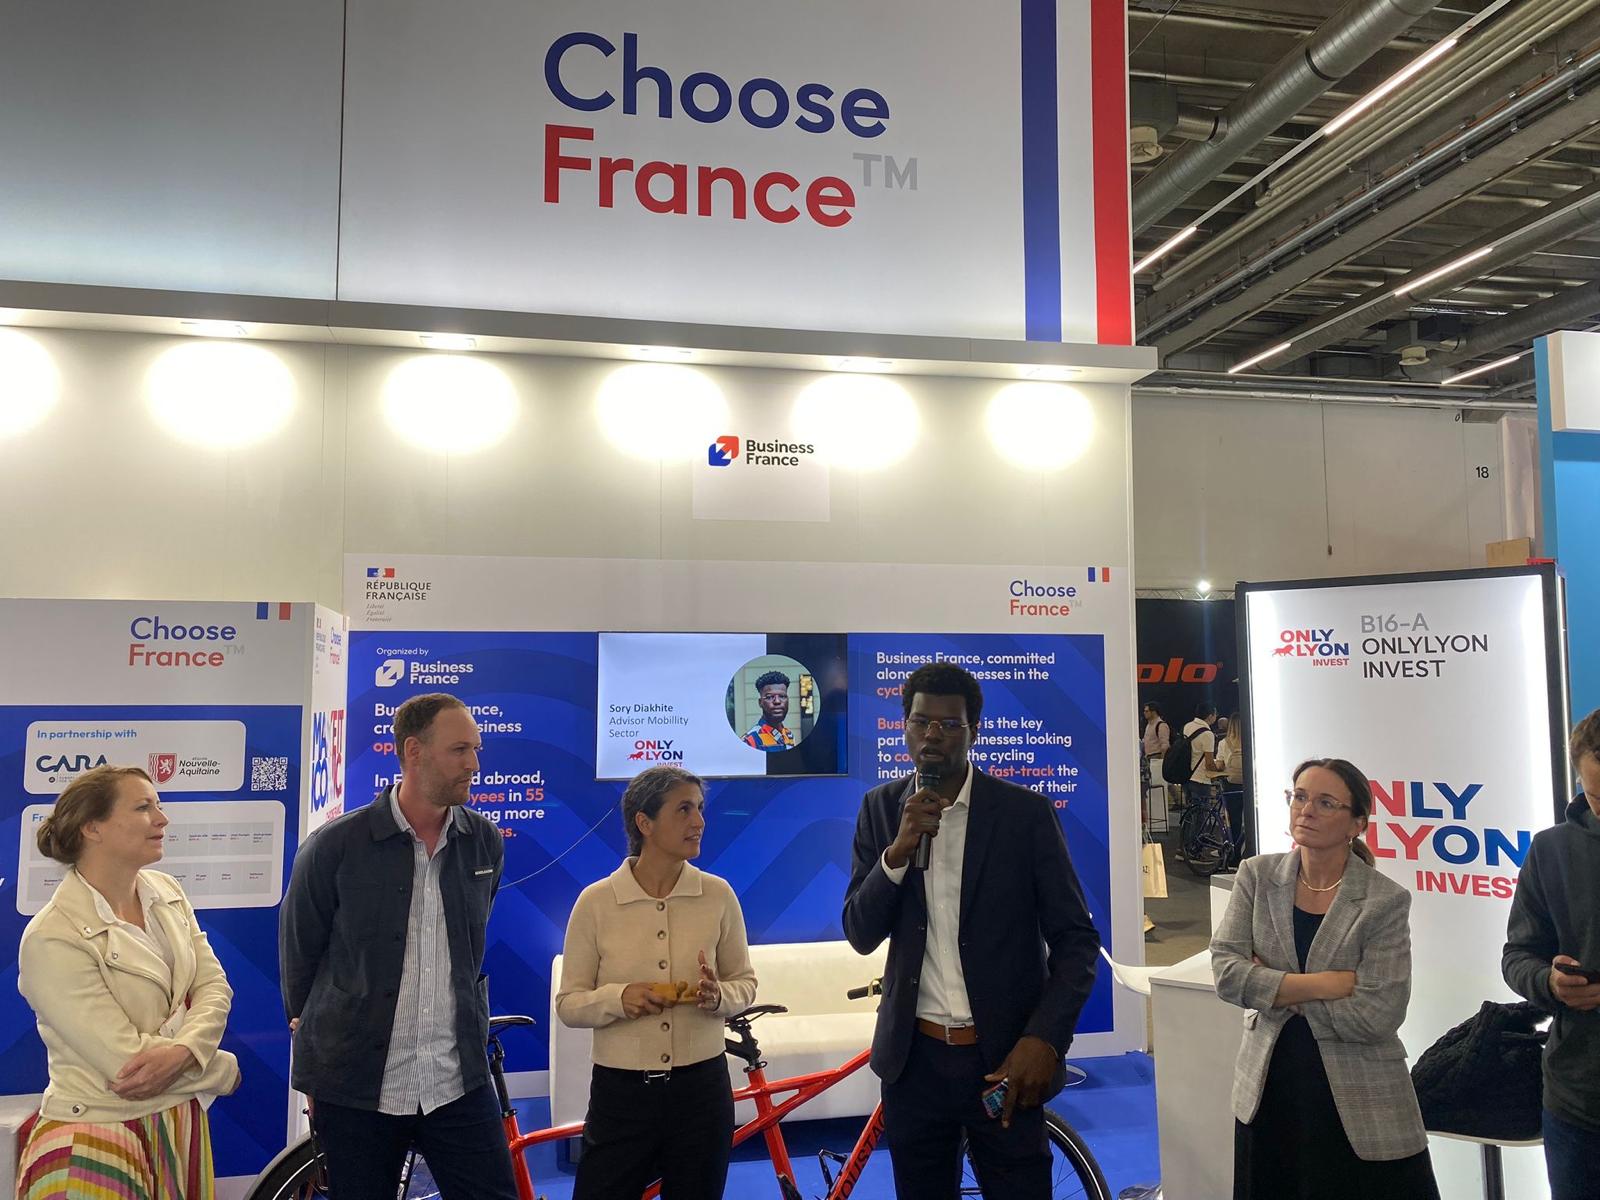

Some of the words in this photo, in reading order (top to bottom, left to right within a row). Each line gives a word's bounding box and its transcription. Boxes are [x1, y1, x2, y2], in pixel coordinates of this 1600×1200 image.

[544, 32, 890, 138] Choose
[544, 123, 856, 228] France
[746, 439, 815, 454] Business
[746, 453, 799, 466] France
[1475, 466, 1489, 479] 18
[366, 580, 432, 592] RÉPUBLIQUE
[1010, 579, 1077, 597] Choose
[366, 591, 427, 601] FRANÇAISE
[1010, 599, 1070, 616] France
[130, 616, 237, 640] Choose
[1361, 613, 1429, 633] B16-A
[1280, 629, 1334, 643] ONLY
[1296, 643, 1350, 657] LYON
[1362, 634, 1488, 655] ONLYLYON
[128, 643, 224, 667] France
[376, 648, 418, 656] Organized
[419, 648, 429, 656] by
[877, 651, 933, 664] Business
[935, 651, 984, 666] France,
[986, 651, 1055, 665] committed
[410, 661, 474, 673] Business
[1312, 658, 1350, 667] INVEST
[1363, 660, 1446, 678] INVEST
[410, 674, 459, 685] France
[966, 669, 1011, 680] nesses
[1014, 668, 1026, 680] in
[1027, 669, 1050, 680] the
[877, 683, 905, 699] cycl
[610, 704, 631, 714] Sory
[633, 703, 674, 713] Diakhite
[477, 719, 522, 733] siness
[609, 716, 645, 726] Advisor
[878, 717, 906, 730] Busi
[984, 717, 994, 729] is
[996, 717, 1019, 729] the
[1020, 717, 1043, 734] key
[37, 730, 48, 739] In
[49, 730, 112, 740] partnership
[114, 729, 137, 739] with
[609, 729, 640, 738] Sector
[634, 740, 674, 750] ONLY
[878, 734, 906, 749] part
[1026, 733, 1072, 749] looking
[646, 750, 683, 761] LYON
[878, 750, 892, 762] to
[967, 749, 988, 761] the
[990, 749, 1035, 765] cycling
[179, 759, 221, 768] Nouvelle-
[988, 764, 1055, 777] fast-track
[1057, 764, 1079, 776] the
[179, 767, 221, 777] Aquitaine
[375, 774, 389, 788] In
[484, 771, 545, 786] abroad,
[1030, 780, 1045, 793] of
[1047, 780, 1077, 793] their
[471, 792, 505, 806] yees
[508, 789, 522, 802] in
[525, 788, 545, 801] 55
[1054, 799, 1069, 809] or
[1368, 780, 1484, 821] NLY
[504, 809, 545, 820] more
[1365, 821, 1531, 868] LYON
